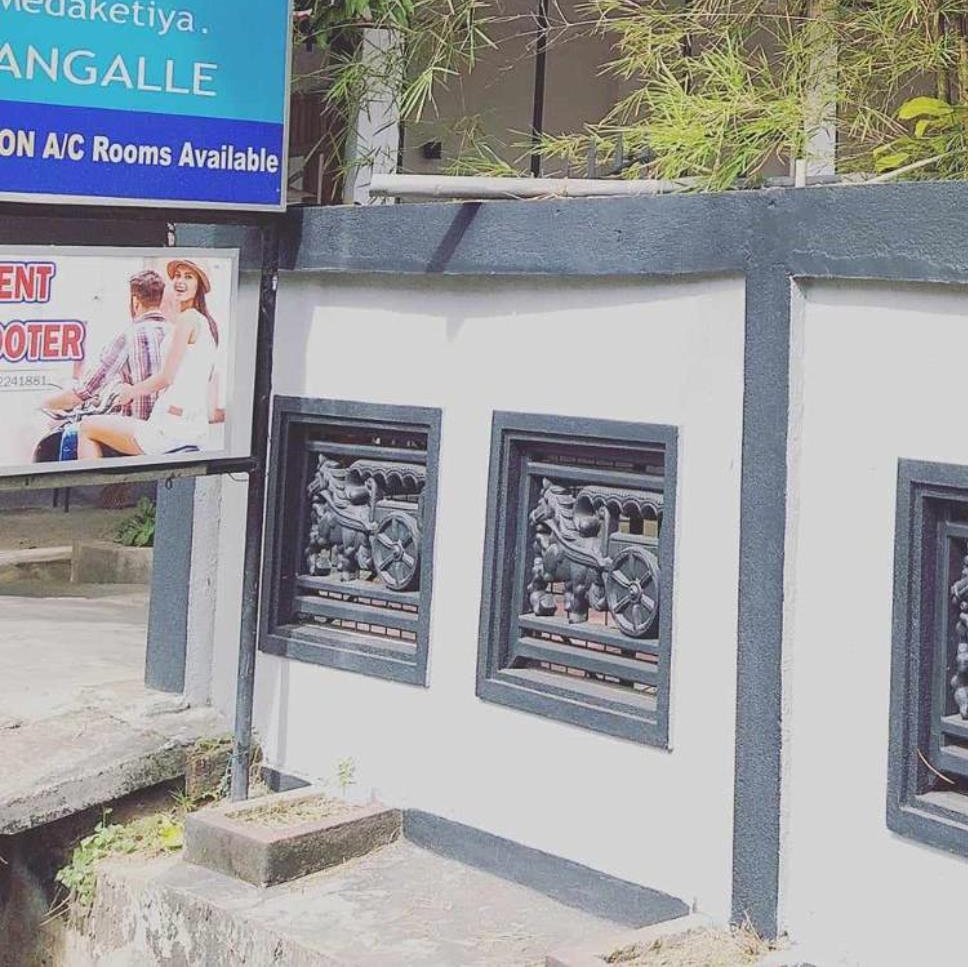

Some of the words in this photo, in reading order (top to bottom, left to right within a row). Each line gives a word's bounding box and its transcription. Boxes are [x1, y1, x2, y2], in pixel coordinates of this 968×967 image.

[0, 128, 35, 158] ON
[42, 133, 84, 161] A/C
[92, 135, 172, 167] Rooms
[178, 142, 279, 173] Available
[0, 262, 55, 302] ENT
[0, 320, 85, 361] OTER
